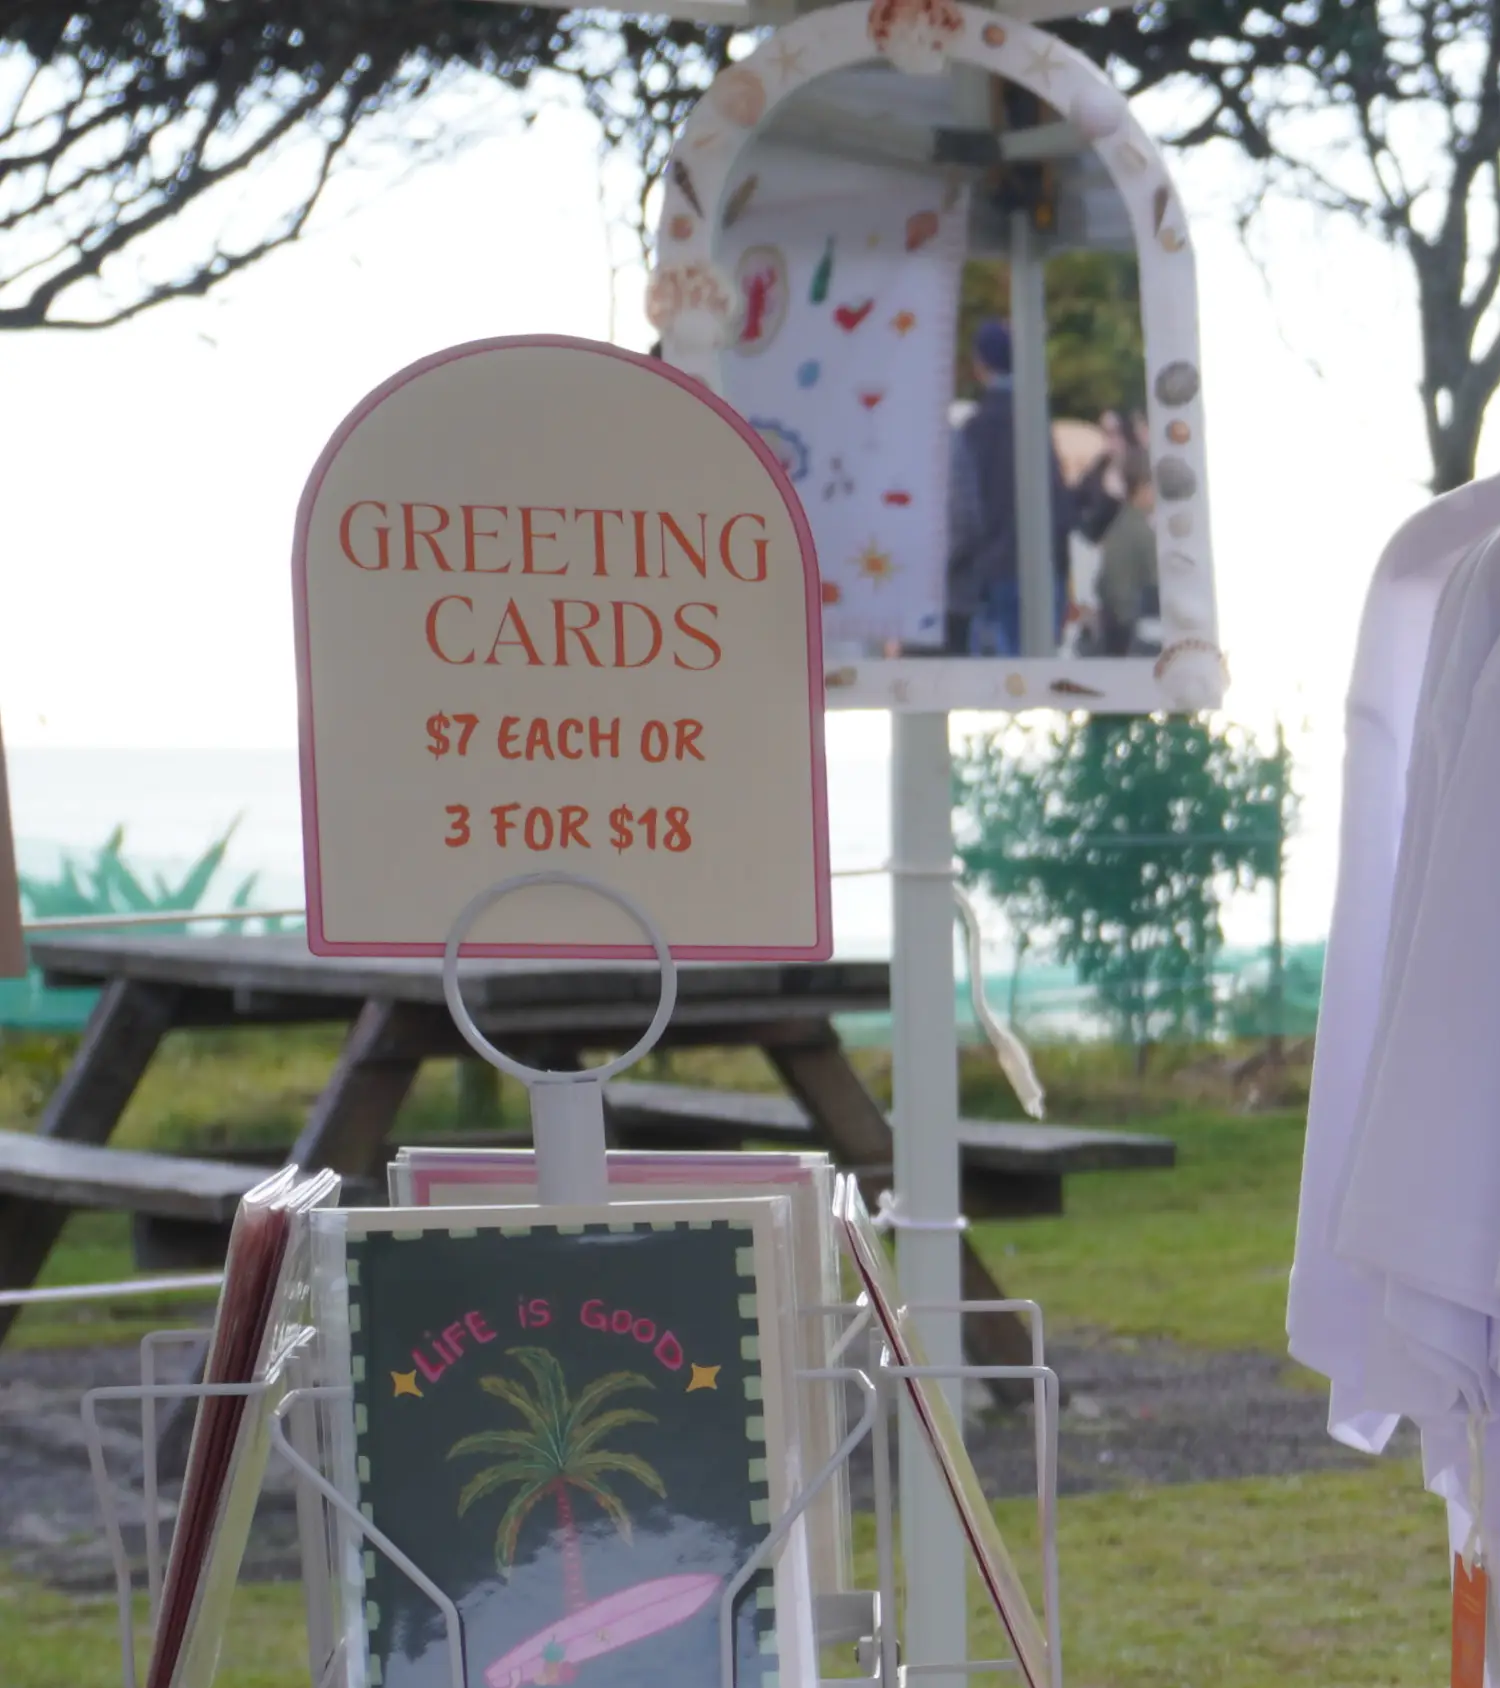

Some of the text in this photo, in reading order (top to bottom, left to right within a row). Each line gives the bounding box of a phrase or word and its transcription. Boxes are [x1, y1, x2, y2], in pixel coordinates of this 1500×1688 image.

[339, 500, 770, 582] GREETING
[425, 595, 722, 671] CARDS
[426, 710, 706, 763] $7 EACH OR
[444, 802, 693, 855] 3 FOR $18
